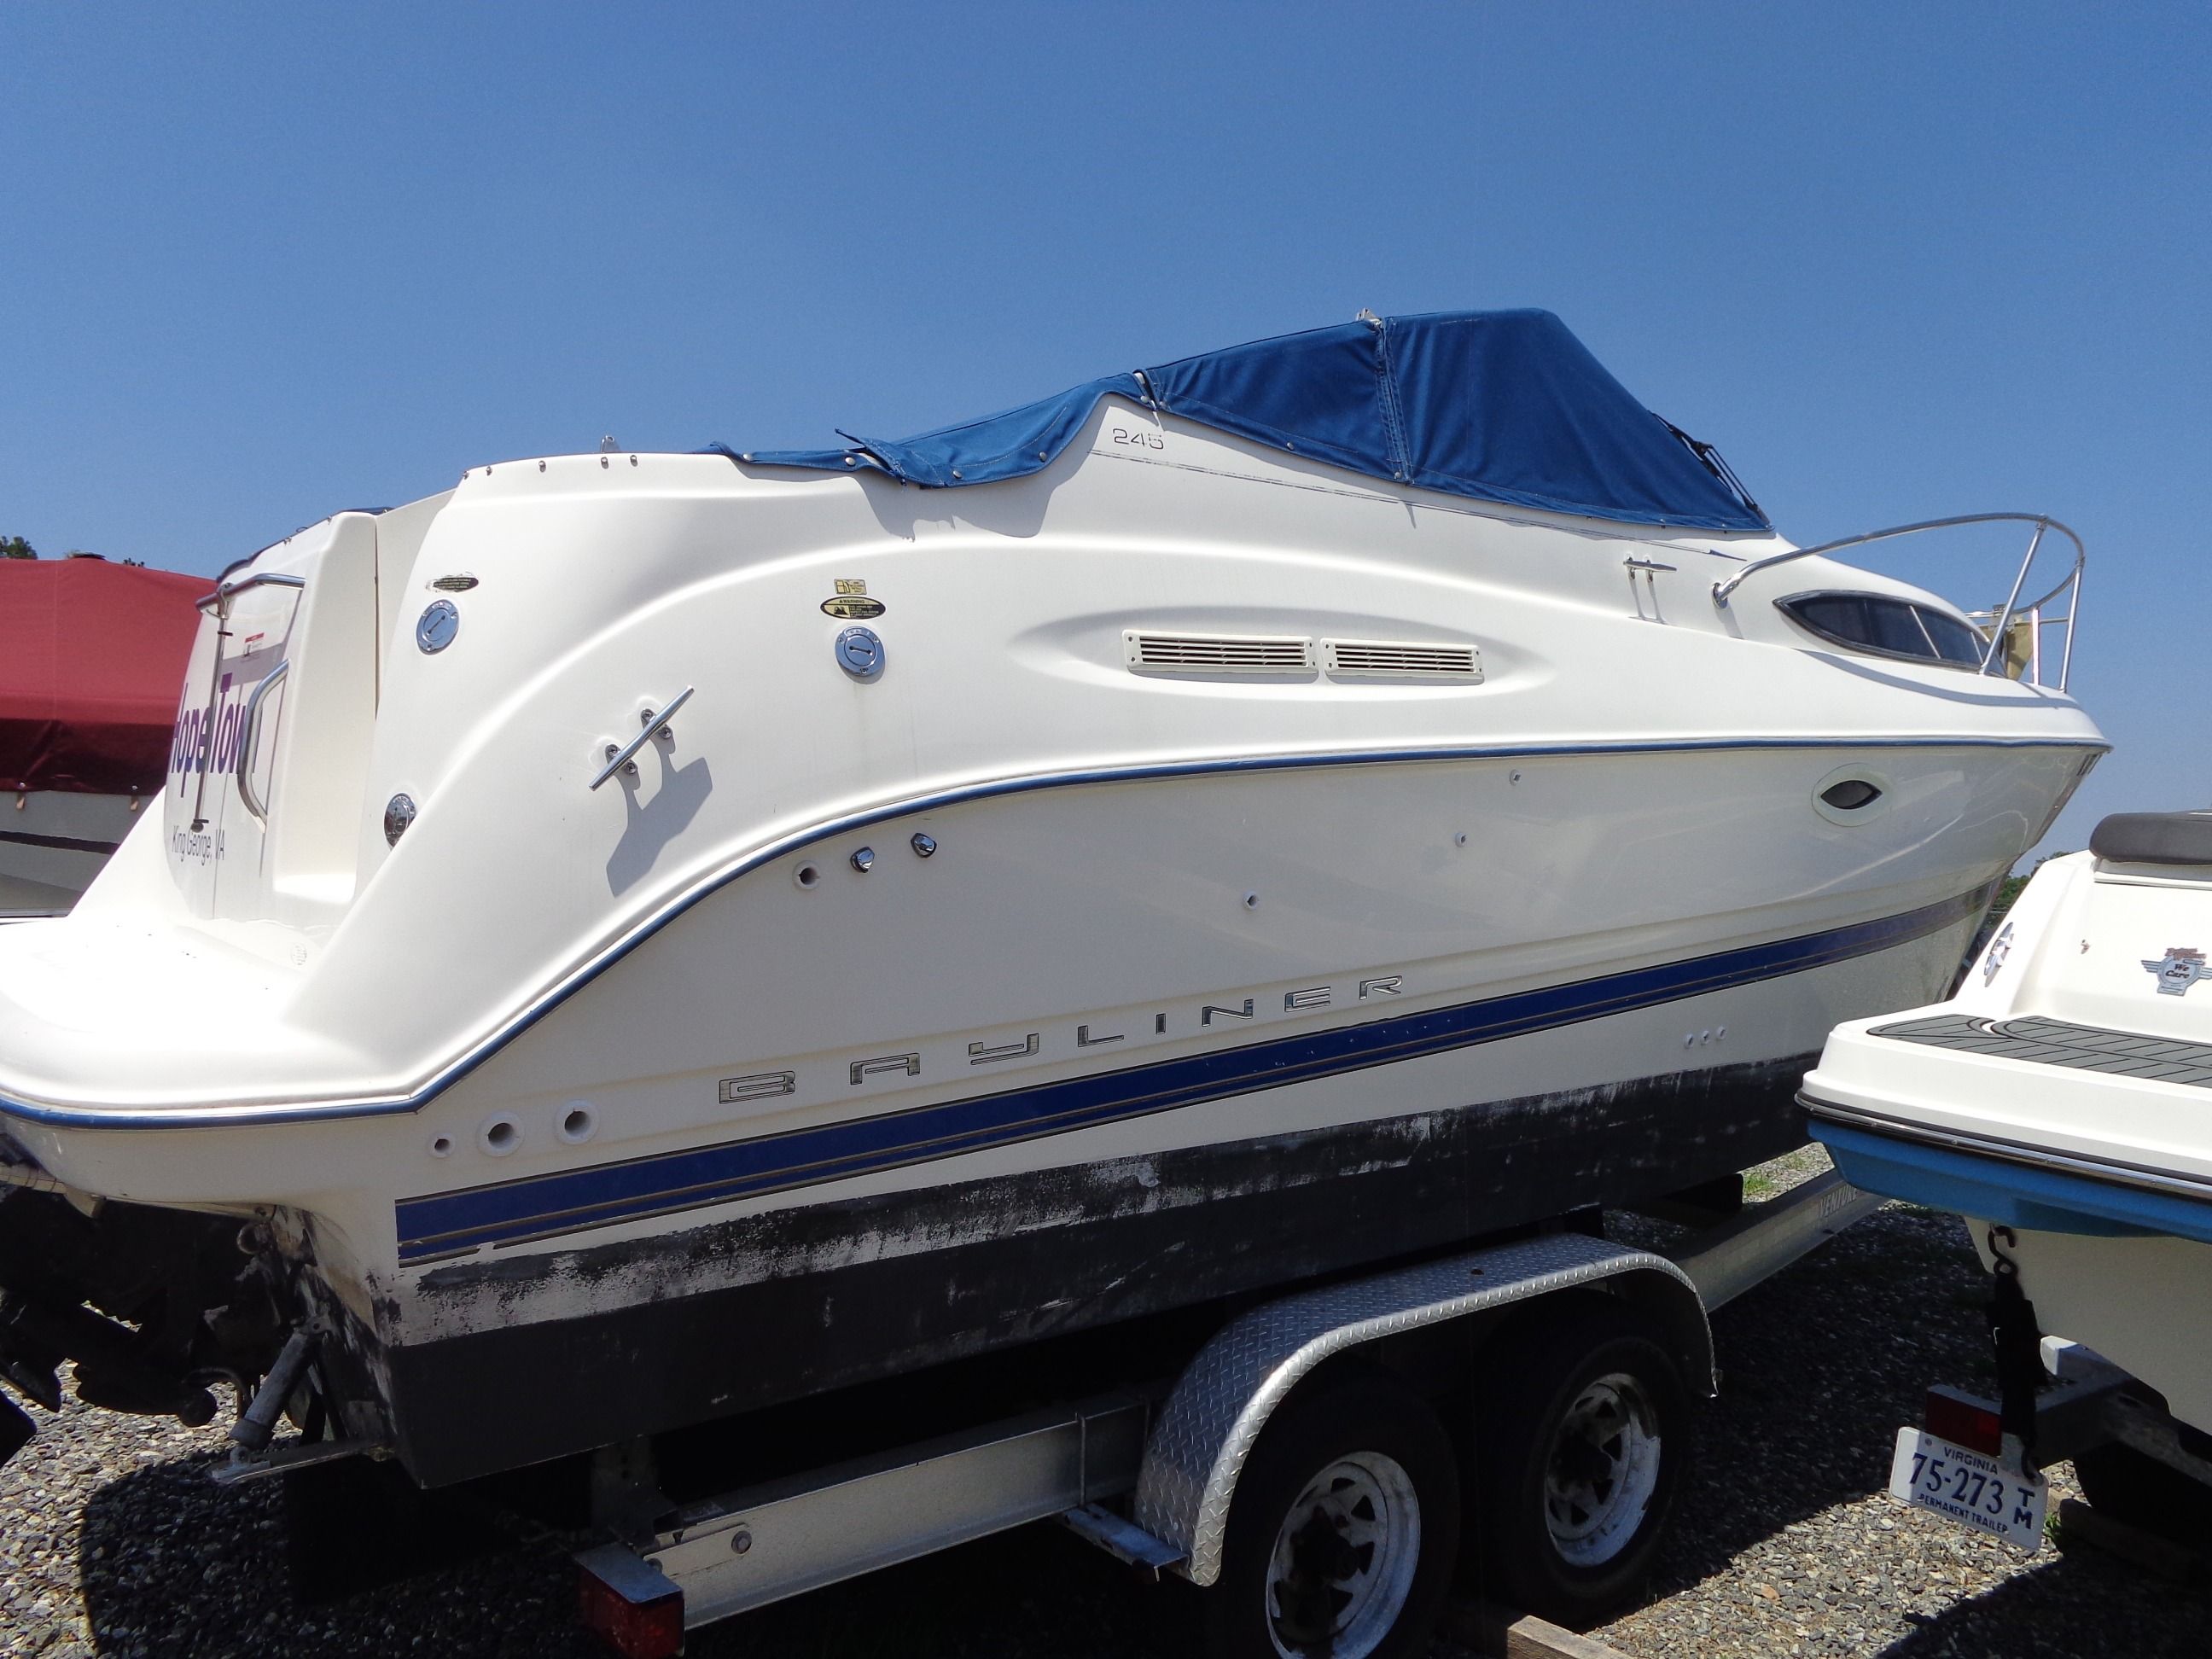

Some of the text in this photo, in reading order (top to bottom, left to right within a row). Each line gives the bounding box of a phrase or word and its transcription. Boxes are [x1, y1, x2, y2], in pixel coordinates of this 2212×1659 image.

[1113, 428, 1164, 450] 245
[172, 824, 186, 862] King
[215, 829, 225, 861] VA
[719, 975, 1403, 1104] BAYLINER
[1943, 1447, 1999, 1476] VIRGINIA
[1909, 1452, 2005, 1515] 75-273
[1918, 1493, 2009, 1535] PERMANENT TRAILER
